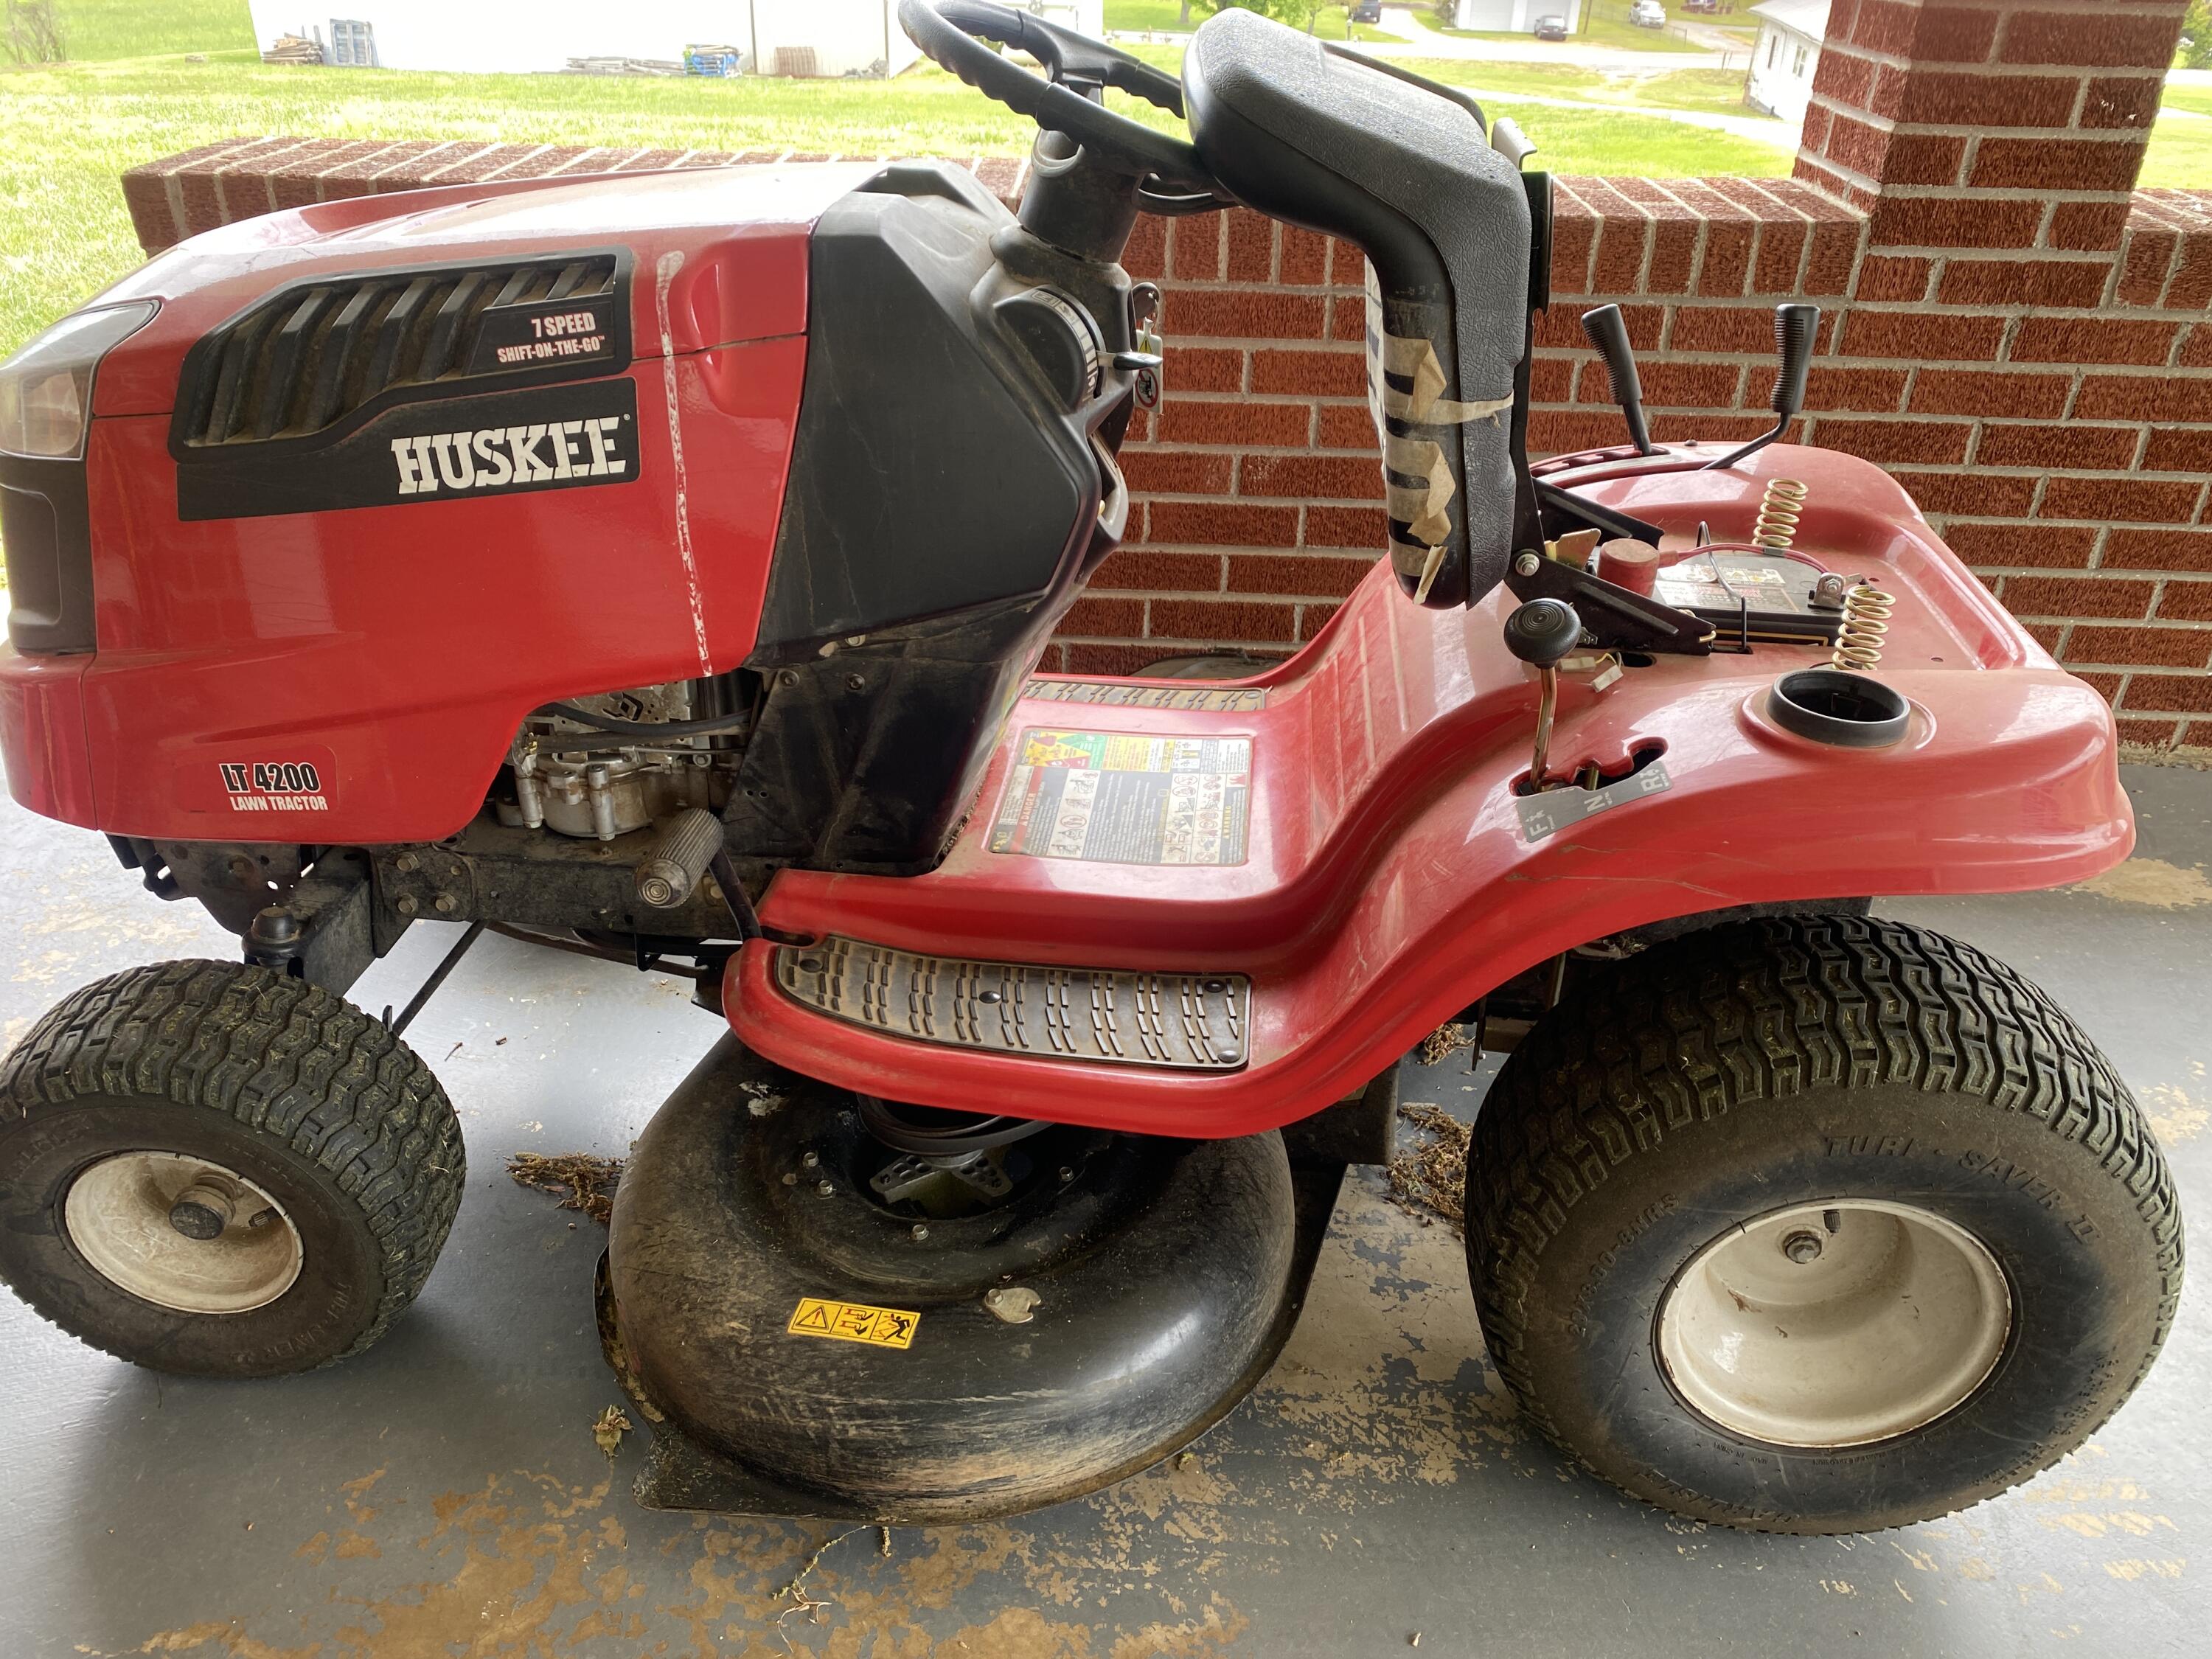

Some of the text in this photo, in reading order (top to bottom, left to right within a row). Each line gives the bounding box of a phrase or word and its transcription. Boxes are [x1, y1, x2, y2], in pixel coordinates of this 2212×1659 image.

[531, 313, 597, 338] 7 SPEED
[219, 762, 321, 793] LT 4200
[229, 796, 328, 811] LAWN TRACTOR
[1022, 793, 1036, 820] DANGER
[1583, 795, 1607, 813] N
[1528, 821, 1549, 837] F
